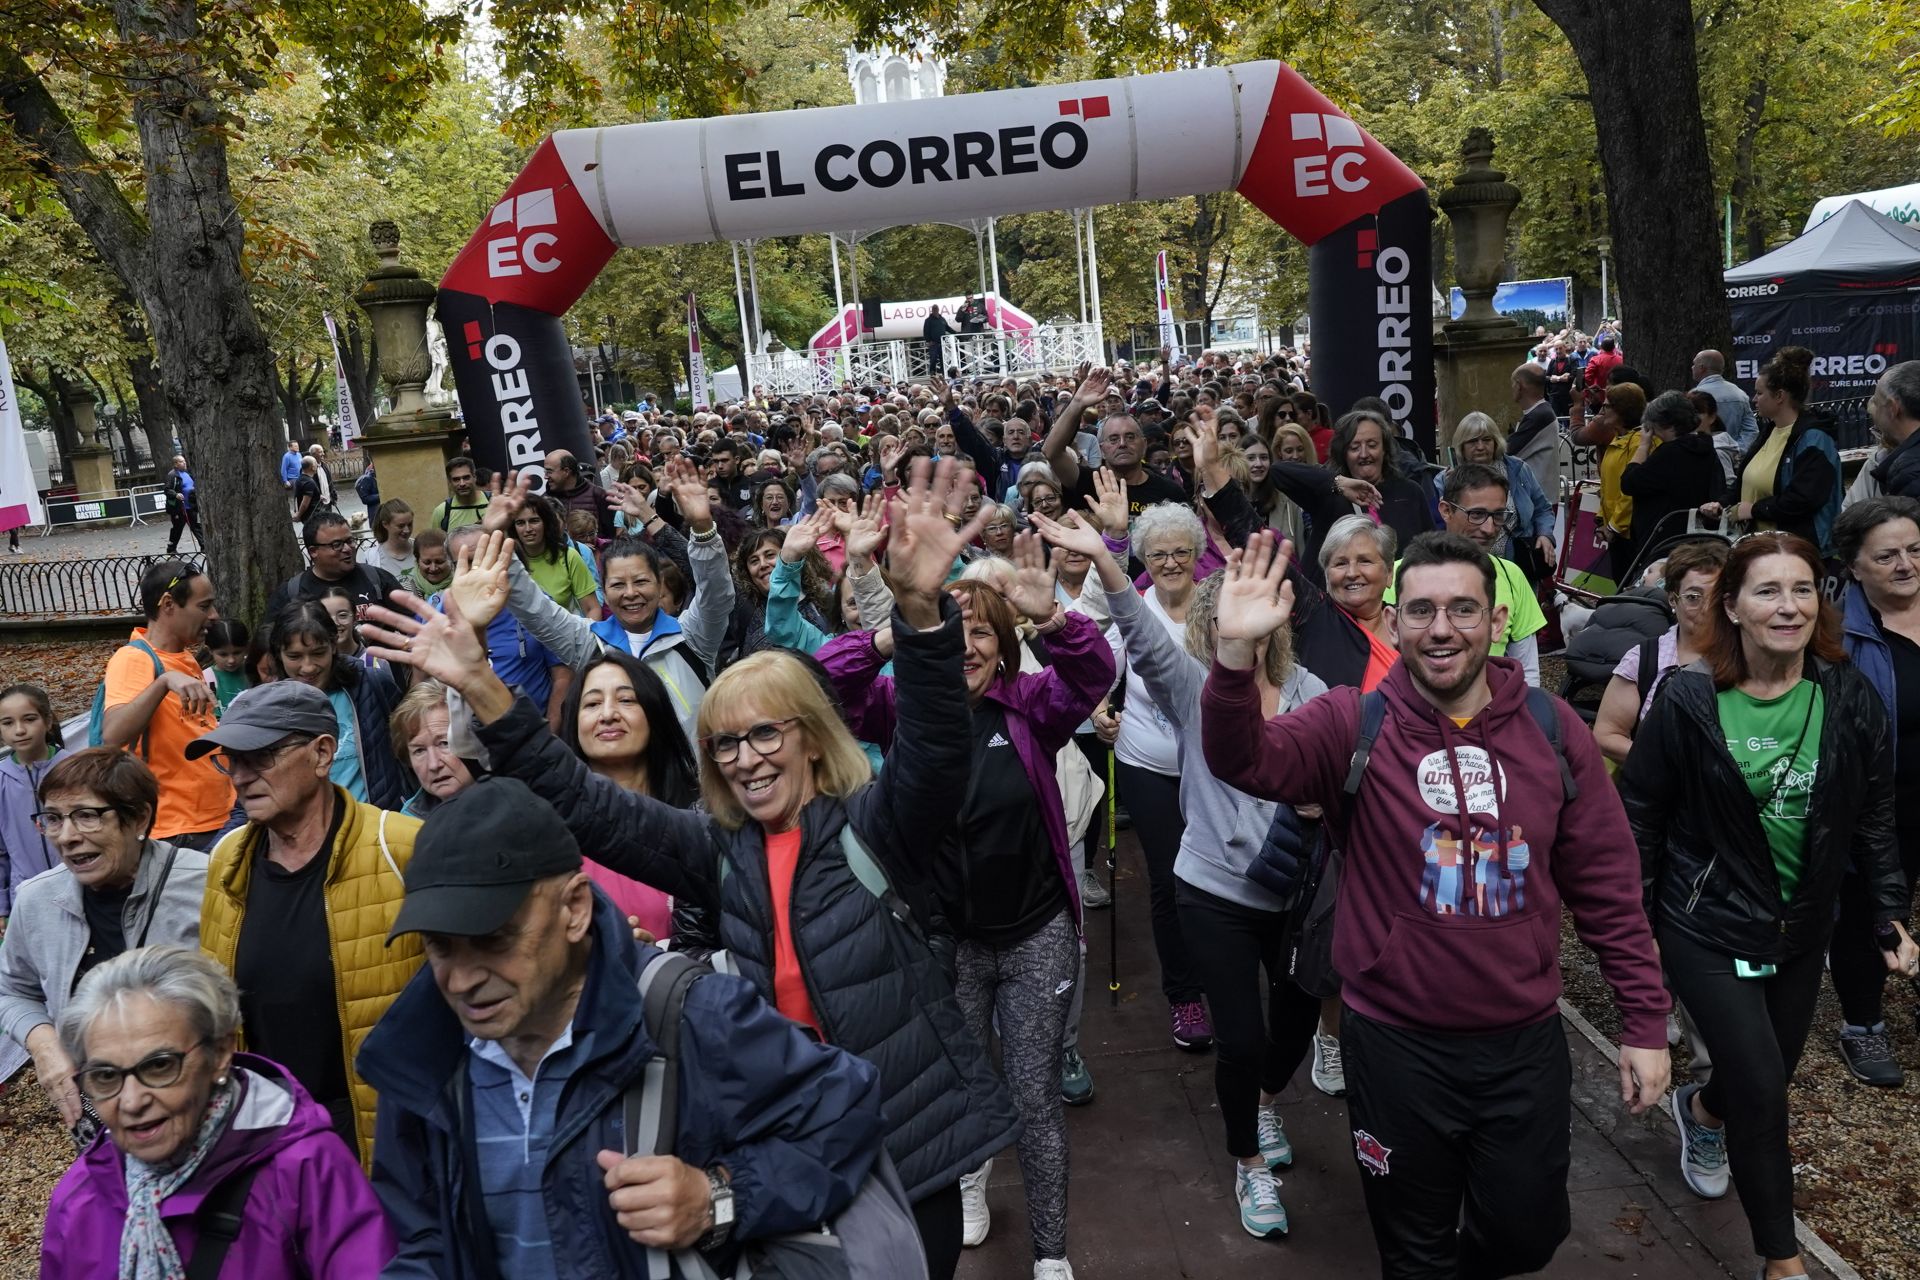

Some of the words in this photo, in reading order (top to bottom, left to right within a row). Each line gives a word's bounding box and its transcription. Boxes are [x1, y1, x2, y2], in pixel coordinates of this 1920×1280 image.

[725, 150, 806, 201] EL
[814, 121, 1089, 192] CORREO
[1293, 152, 1370, 197] EC
[487, 232, 562, 278] EC
[1725, 284, 1779, 299] ORREO
[1791, 327, 1803, 335] EL
[1804, 325, 1841, 335] CORREO
[1735, 359, 1760, 379] EL
[1809, 353, 1887, 377] RREO
[691, 356, 703, 405] LABORAL
[1829, 380, 1851, 388] ZURE
[339, 382, 354, 438] LABORAL
[485, 333, 547, 496] ORREO
[1464, 759, 1488, 771] hacer
[1424, 770, 1503, 793] amgos
[1436, 796, 1452, 806] que
